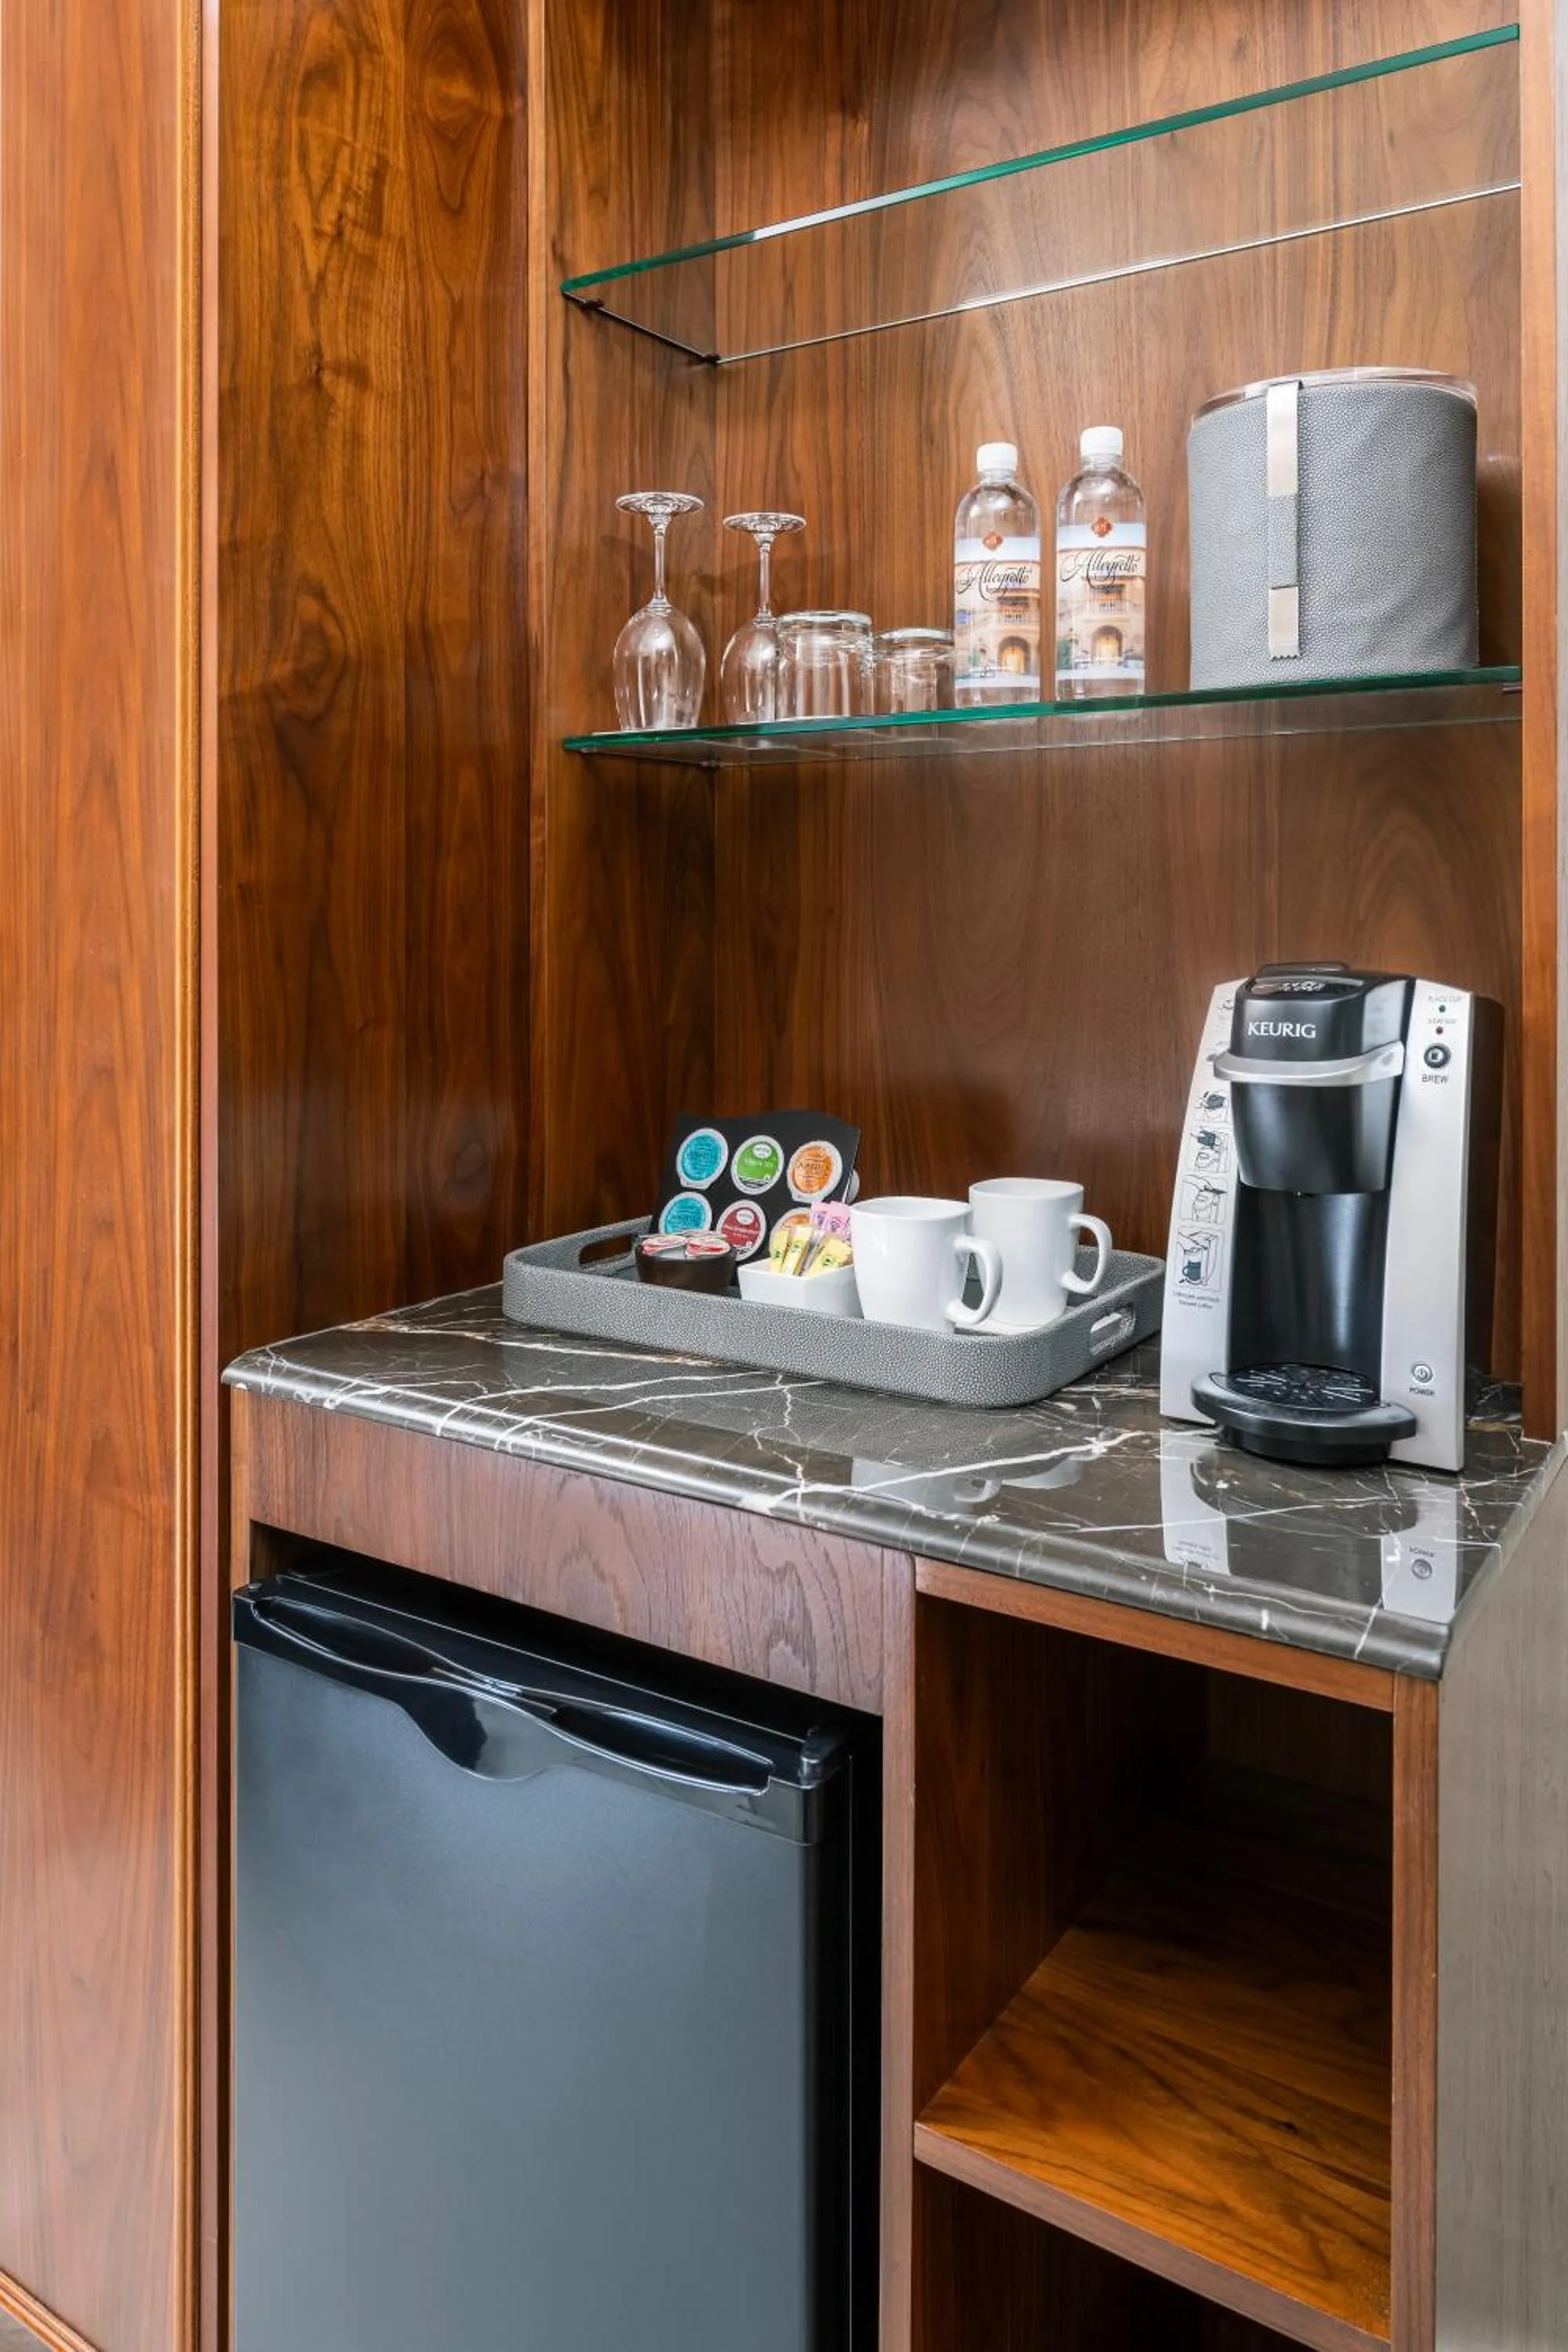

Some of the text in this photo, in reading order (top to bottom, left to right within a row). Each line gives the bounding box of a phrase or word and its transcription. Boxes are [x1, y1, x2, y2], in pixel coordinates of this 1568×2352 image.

[1060, 551, 1142, 590] Allegretto
[1247, 1022, 1317, 1039] KEURIG
[1421, 1073, 1449, 1084] BREW
[1409, 1387, 1436, 1396] POWER
